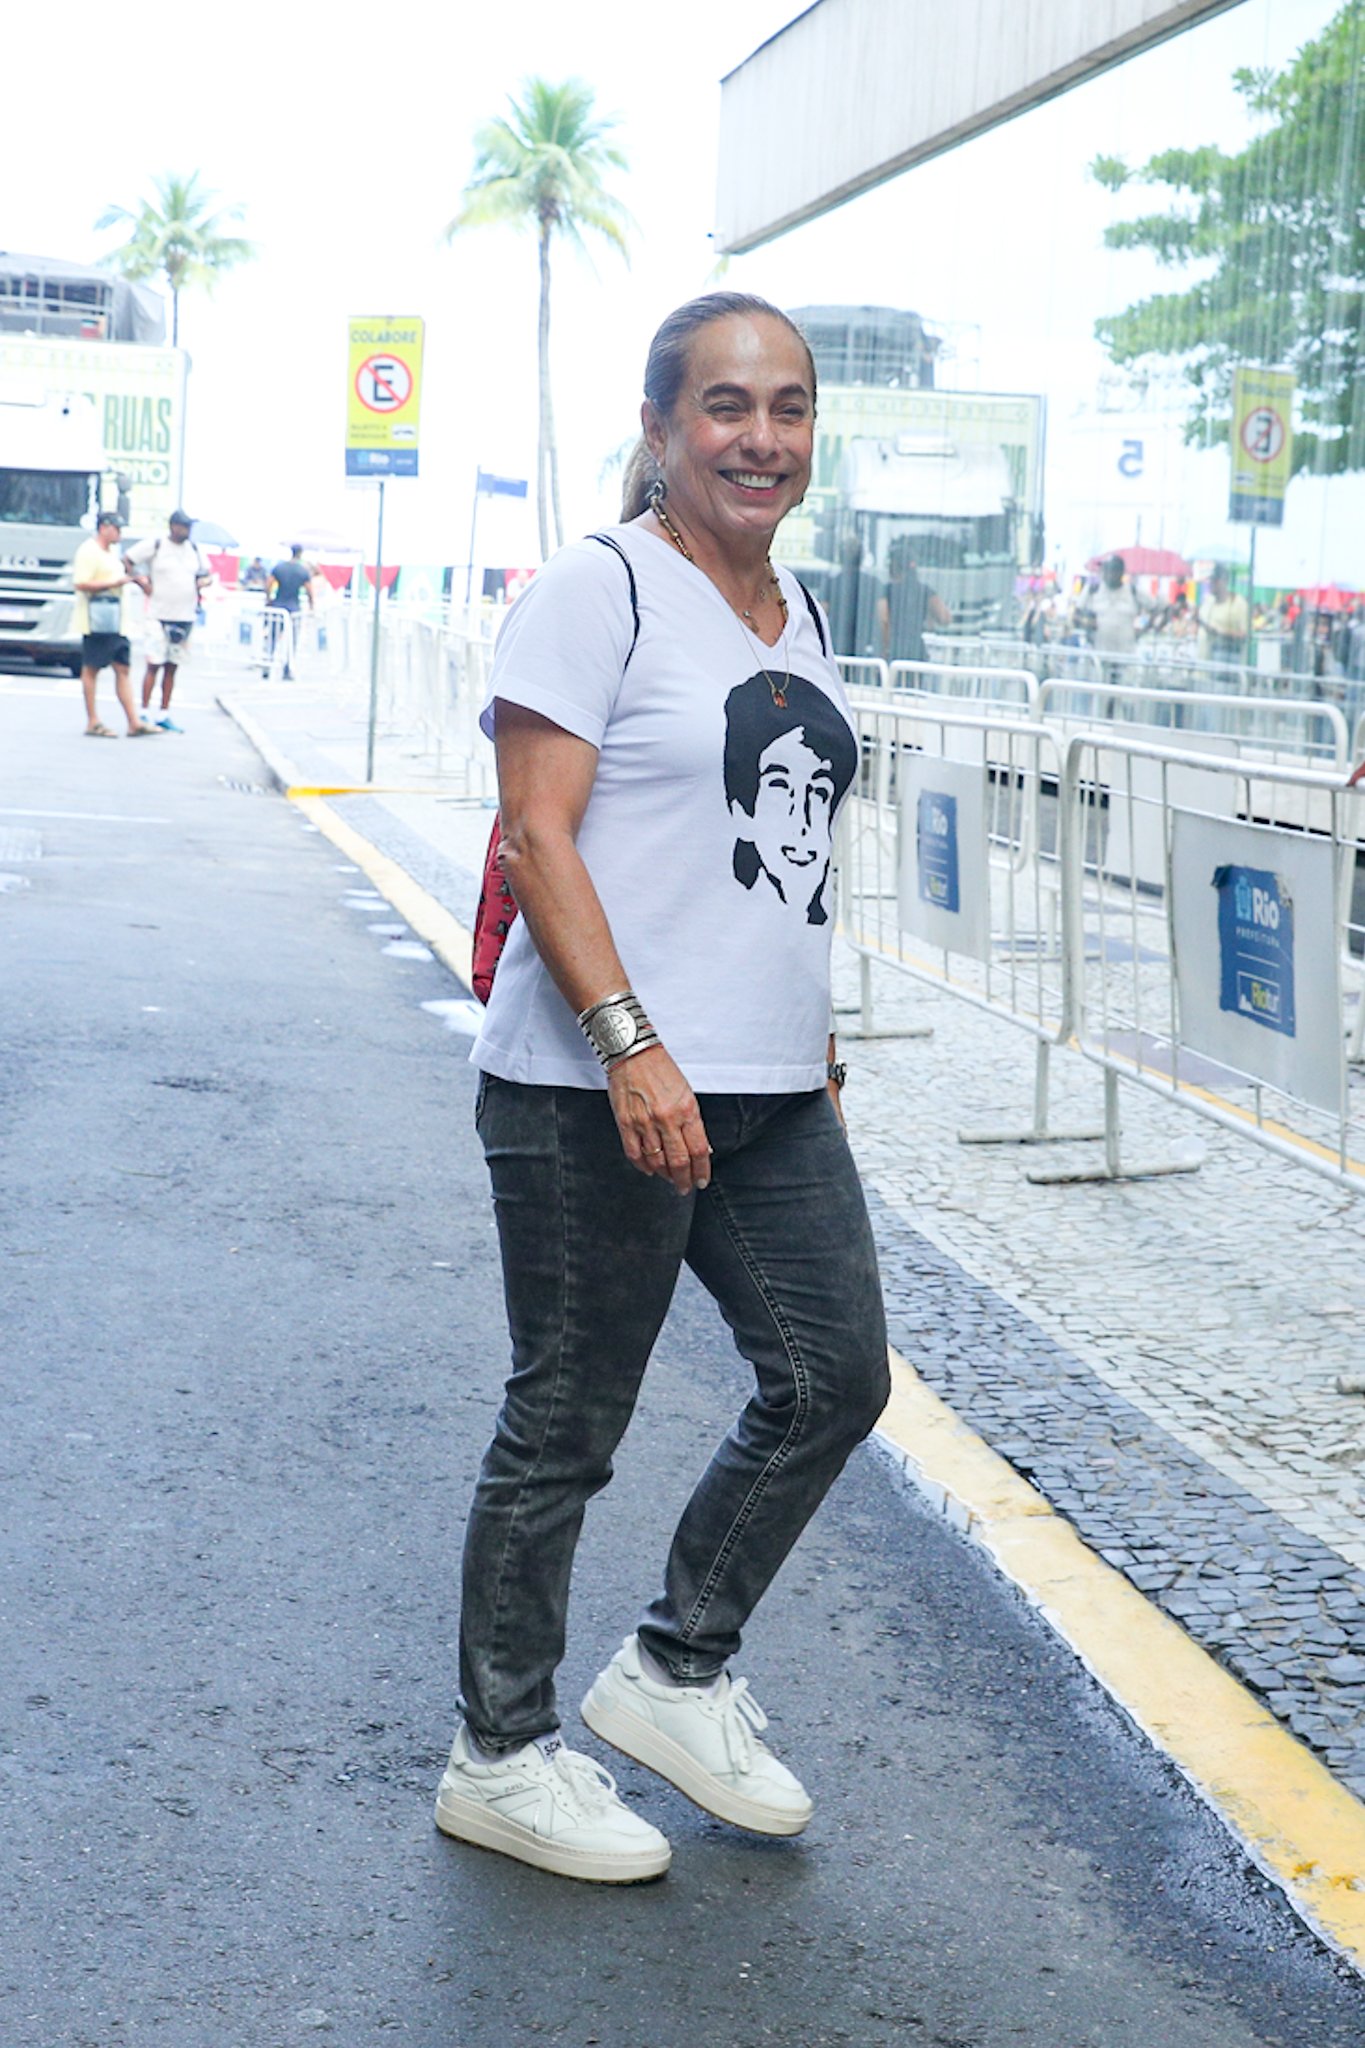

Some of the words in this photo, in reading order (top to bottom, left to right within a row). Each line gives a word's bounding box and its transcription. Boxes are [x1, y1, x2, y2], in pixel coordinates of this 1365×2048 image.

[351, 329, 417, 344] COLABORE
[103, 393, 173, 454] RUAS
[931, 805, 949, 836] Rio
[1251, 885, 1281, 931] Rio
[1235, 925, 1281, 948] PREFEITURA
[1250, 980, 1281, 1014] Riotur
